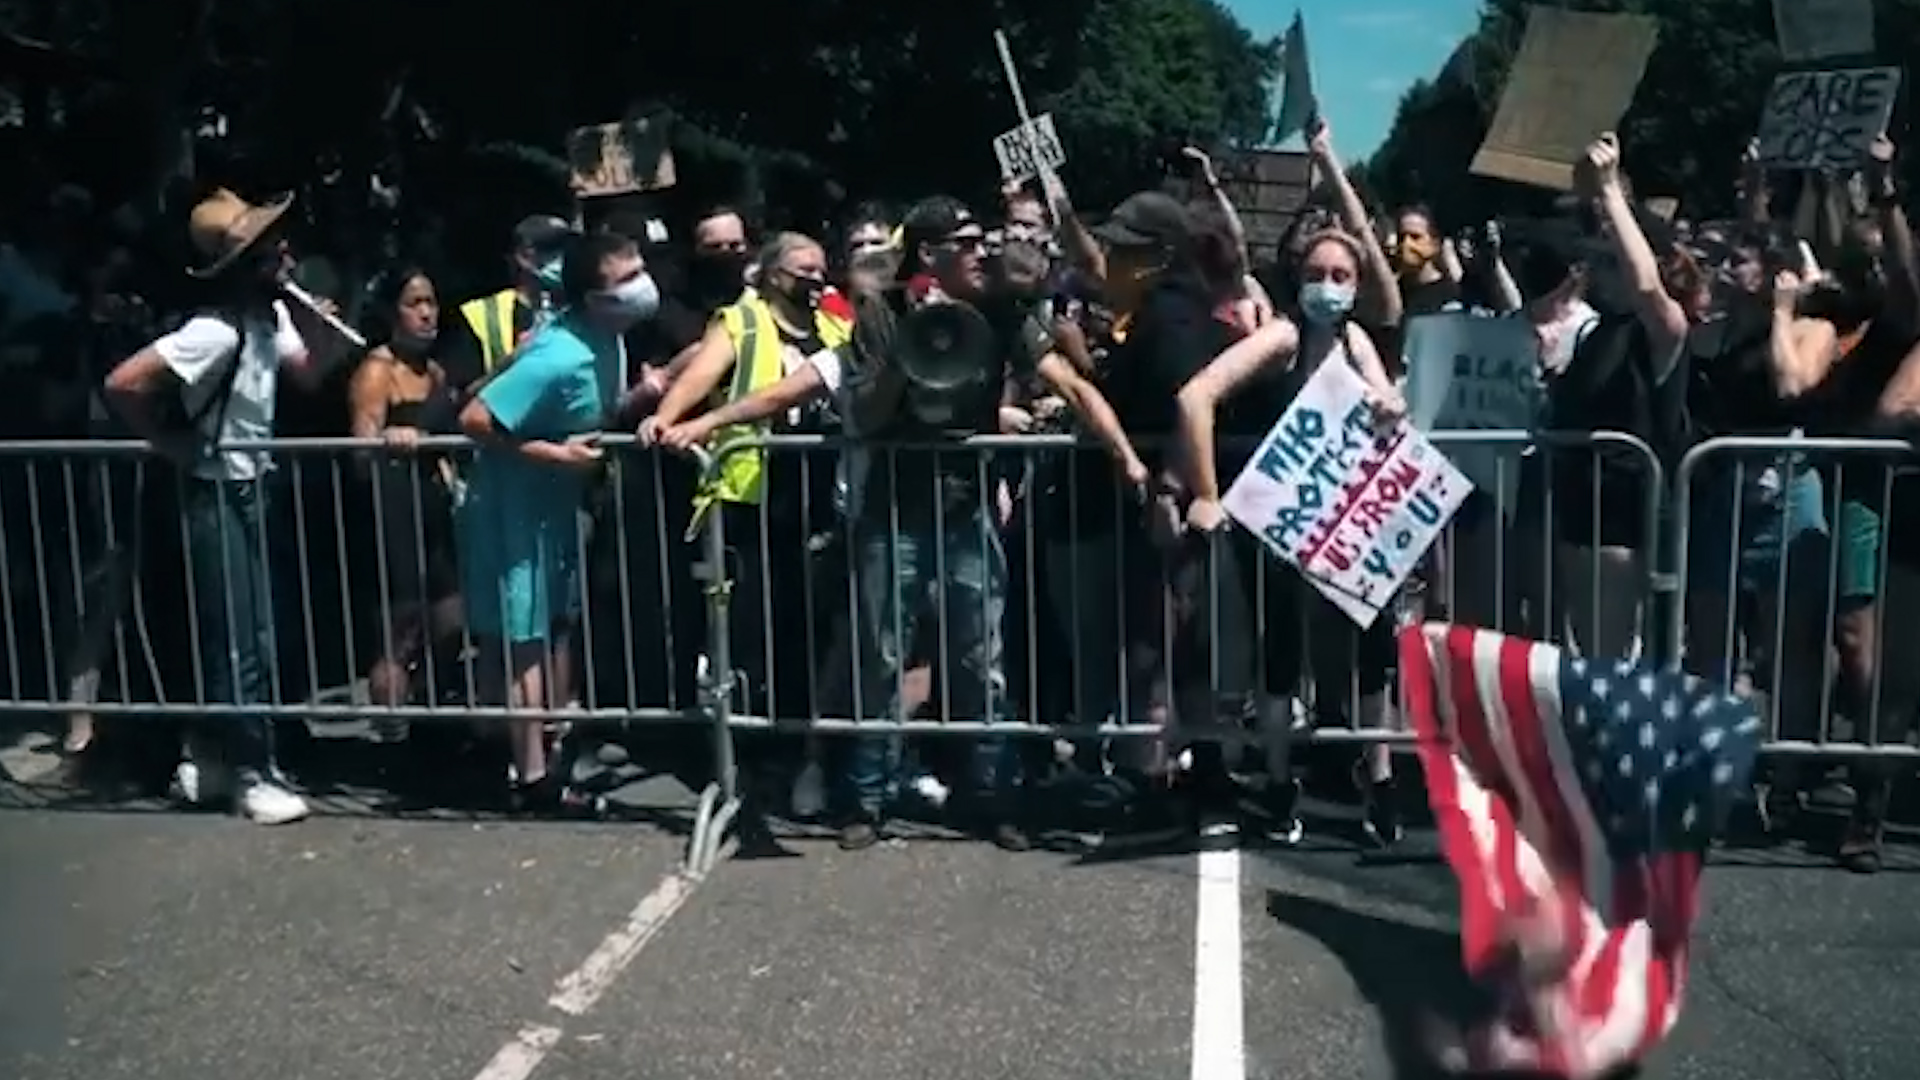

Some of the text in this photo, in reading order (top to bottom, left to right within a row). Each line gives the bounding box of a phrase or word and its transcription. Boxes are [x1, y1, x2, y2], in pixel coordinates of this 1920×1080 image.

[1454, 354, 1530, 395] BLAC
[1255, 408, 1325, 484] WHO
[1264, 398, 1382, 552] PROTECT
[1322, 459, 1422, 571] US FROM
